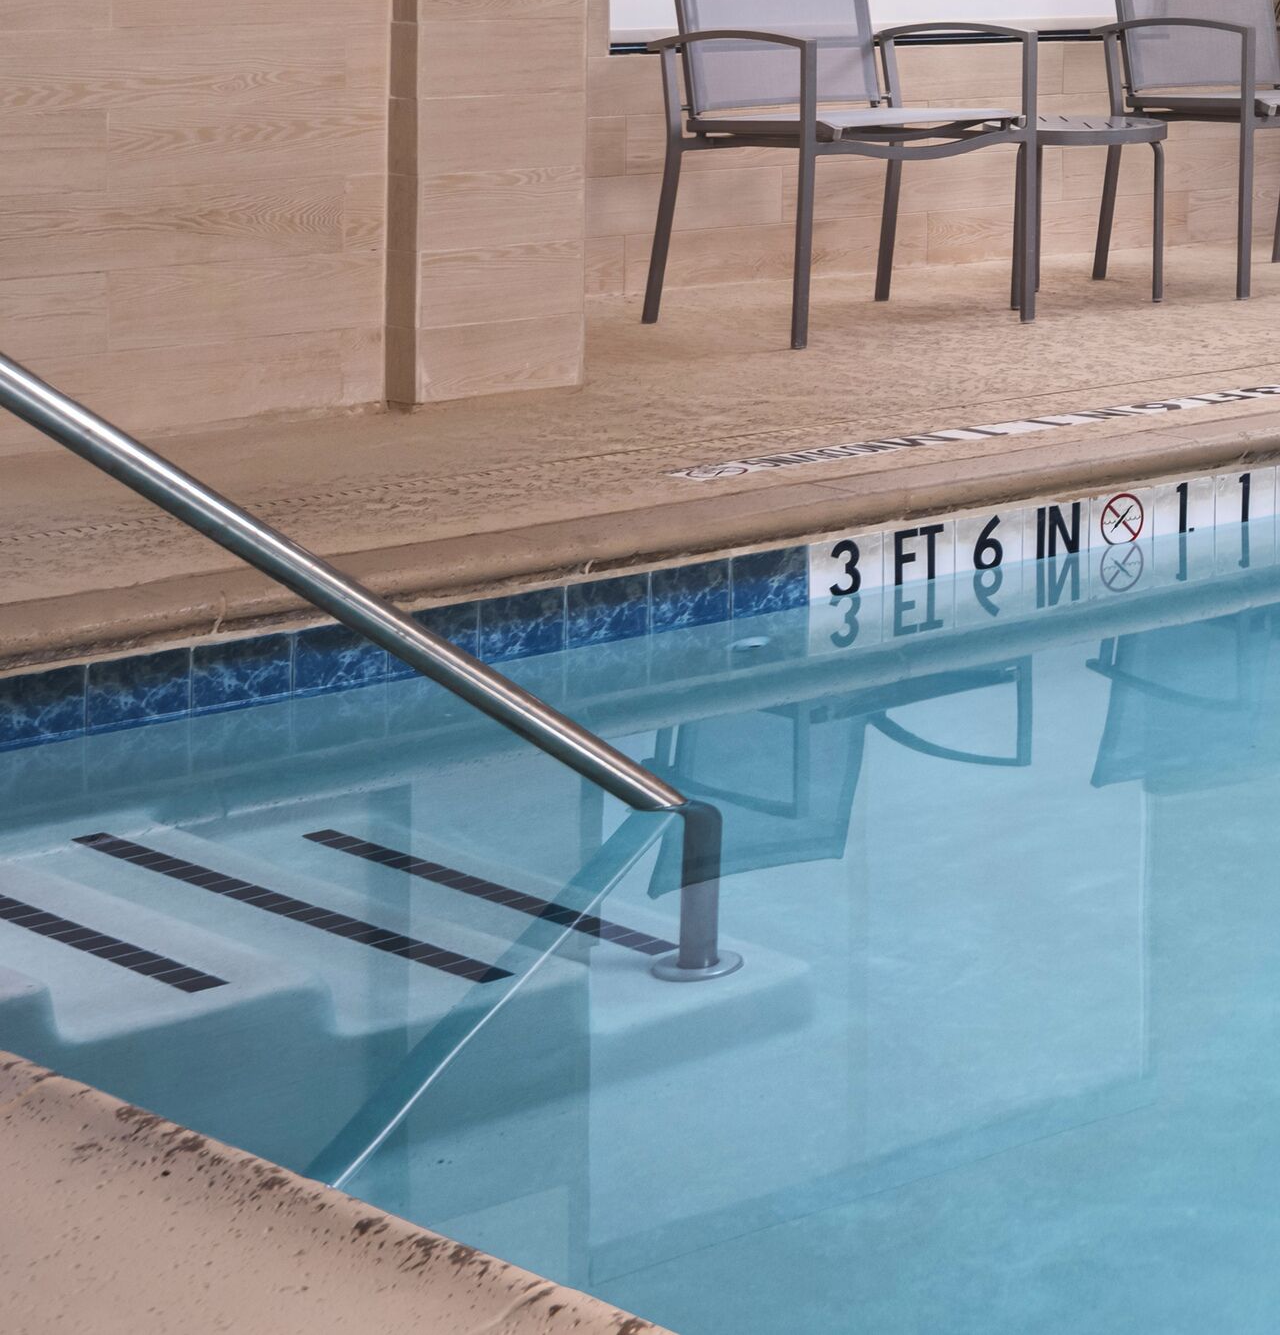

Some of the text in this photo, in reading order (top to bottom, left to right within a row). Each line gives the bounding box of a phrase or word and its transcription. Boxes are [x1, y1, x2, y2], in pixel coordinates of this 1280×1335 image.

[829, 539, 861, 596] 3
[893, 523, 944, 586] FT
[973, 515, 1003, 570] 6
[1036, 502, 1081, 560] IN
